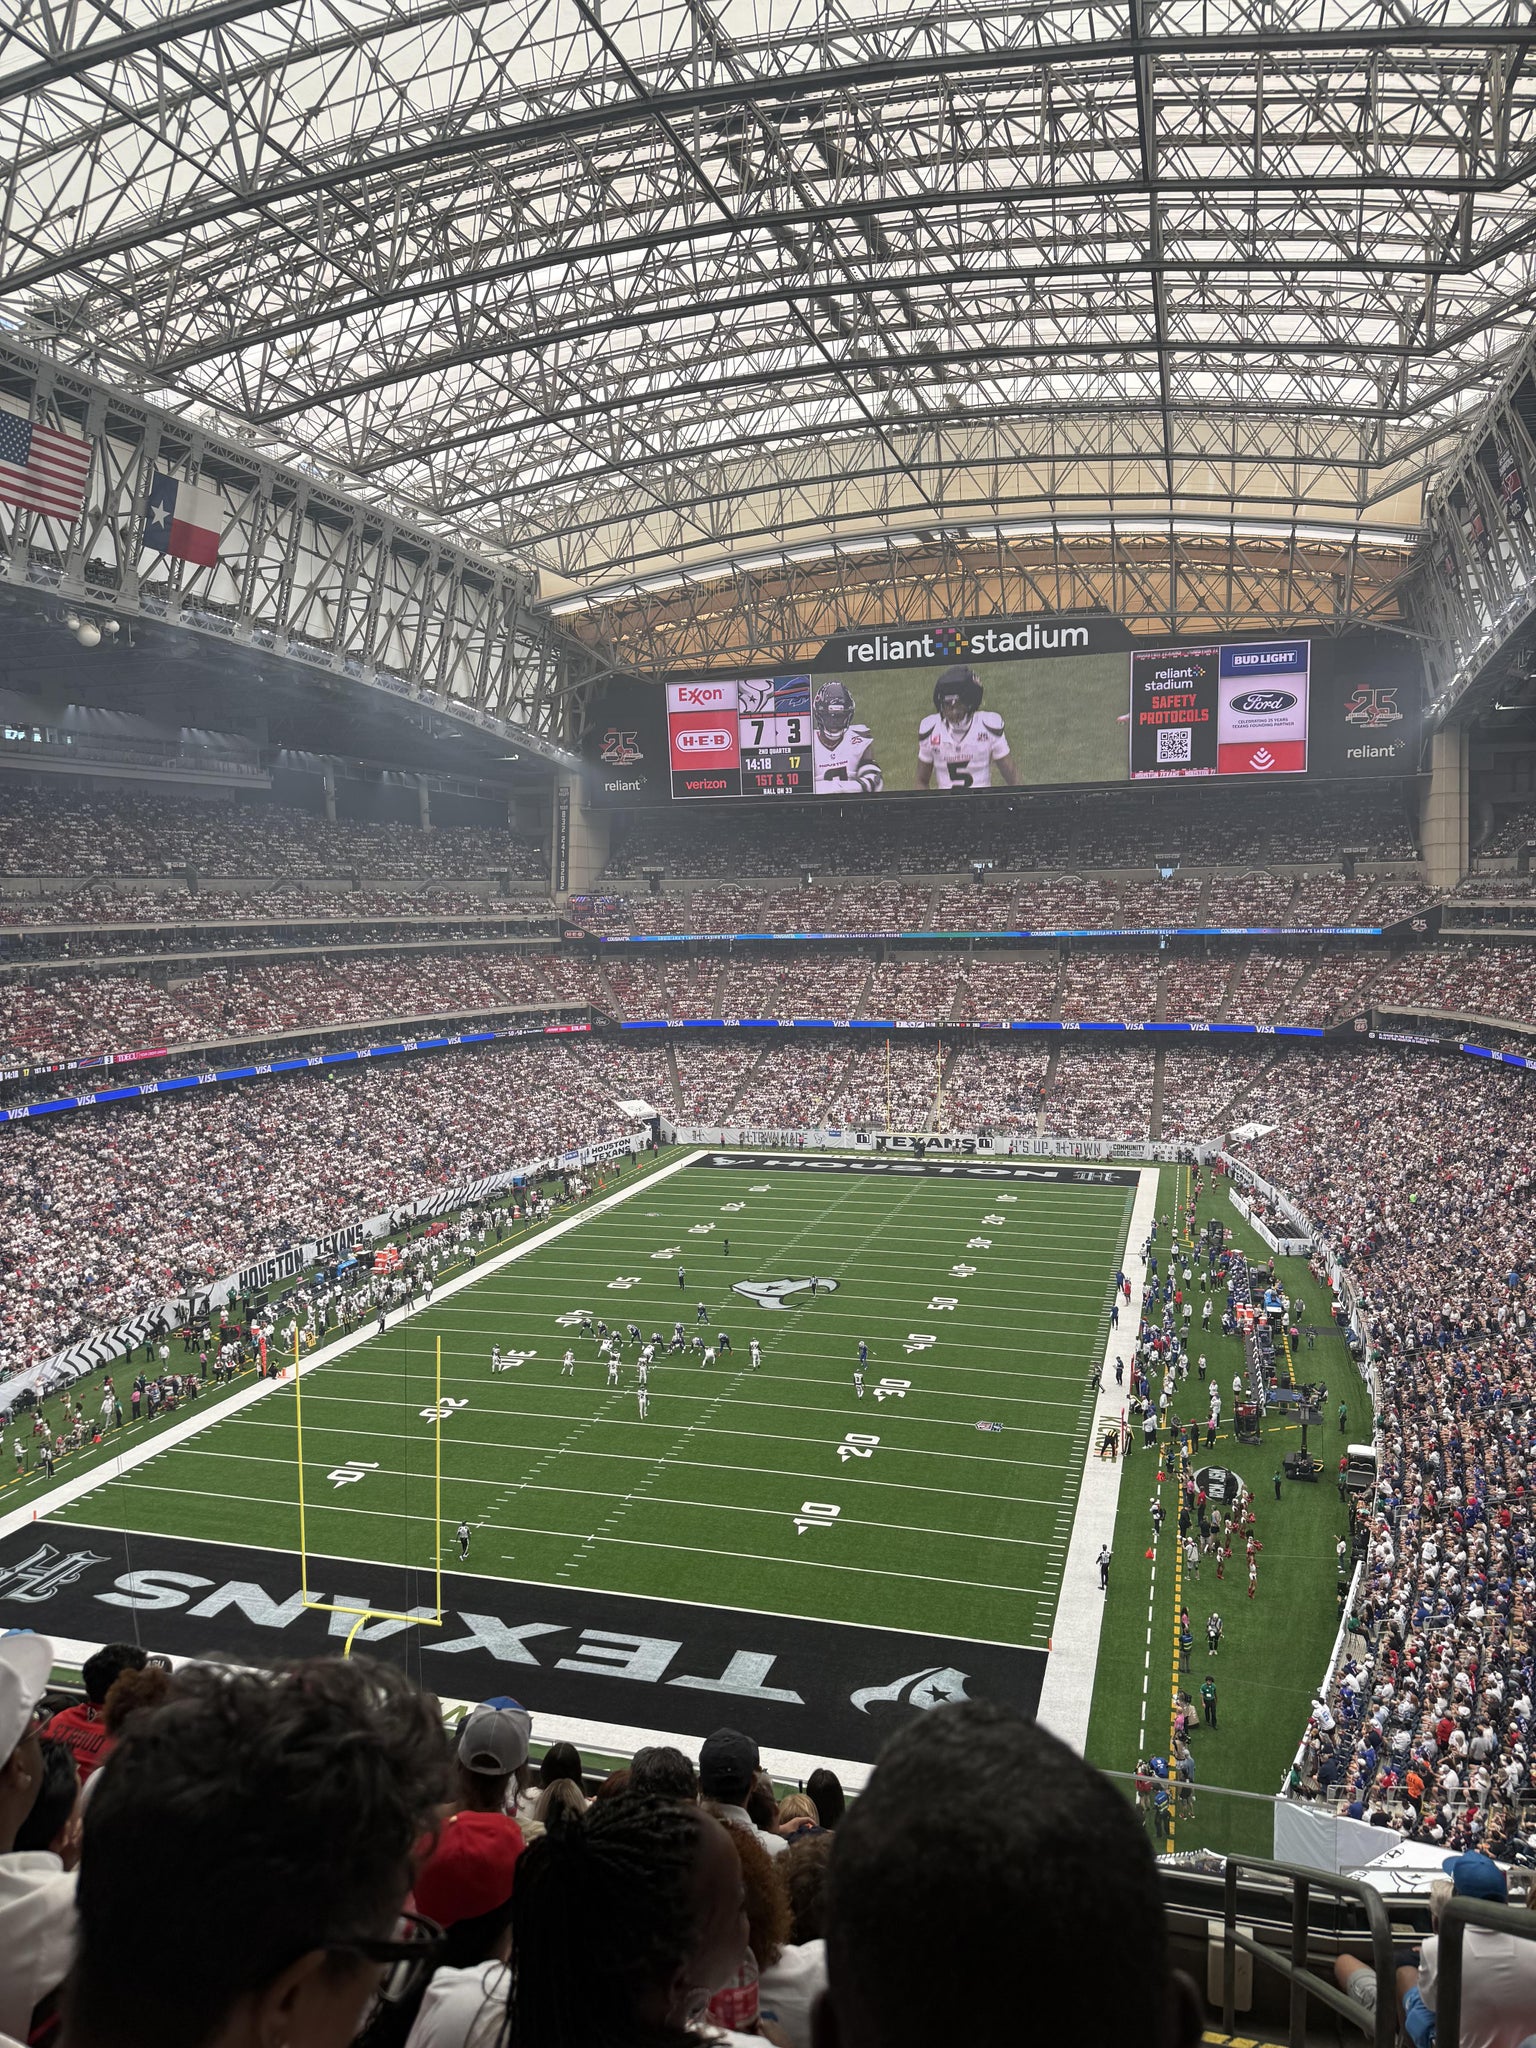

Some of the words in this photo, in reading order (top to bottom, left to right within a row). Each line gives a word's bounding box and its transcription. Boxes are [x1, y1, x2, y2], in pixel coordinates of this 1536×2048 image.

[847, 634, 935, 663] reliant
[970, 623, 1089, 655] stadium
[1234, 655, 1258, 665] BUD
[1260, 653, 1295, 663] LIGHT
[1155, 667, 1193, 679] reliant
[1144, 679, 1193, 691] stadium
[678, 688, 722, 705] Exxon
[1152, 693, 1197, 709] SAFETY
[1243, 693, 1283, 711] Ford
[1351, 688, 1398, 724] 25
[1139, 708, 1209, 725] PROTOCOLS
[751, 720, 764, 745] 7
[787, 718, 801, 743] 3
[604, 731, 639, 762] 25
[1347, 744, 1396, 759] reliant
[745, 757, 772, 770] 14:18
[789, 757, 800, 768] 17
[604, 780, 641, 791] reliant
[685, 778, 727, 790] verizon
[755, 774, 773, 786] 1ST
[776, 774, 784, 785] &
[787, 773, 799, 785] 10
[832, 1020, 850, 1028] VISA
[1060, 1022, 1080, 1030] VISA
[1124, 1023, 1145, 1031] VISA
[1189, 1023, 1210, 1032] VISA
[1255, 1025, 1276, 1034] VISA
[403, 1042, 418, 1051] VISA
[447, 1036, 462, 1045] VISA
[1491, 1050, 1503, 1061] VISA
[23, 1069, 30, 1077] 17
[7, 1106, 30, 1120] VISA
[76, 1094, 97, 1106] VISA
[139, 1083, 159, 1095] VISA
[198, 1073, 217, 1084] VISA
[255, 1064, 272, 1075] VISA
[307, 1056, 323, 1066] VISA
[356, 1049, 372, 1059] VISA
[591, 1138, 631, 1155] HOUSTON
[875, 1135, 977, 1150] TEXANS
[1113, 1143, 1145, 1151] COMMUNITY
[592, 1145, 631, 1161] TEXANS
[763, 1160, 1059, 1178] HOUSTON
[315, 1223, 363, 1256] TEXANS
[239, 1247, 304, 1290] HOUSTON
[948, 1264, 977, 1278] 40
[607, 1276, 641, 1290] 50
[927, 1296, 959, 1311] 50
[555, 1309, 594, 1324] 40
[902, 1333, 937, 1350] 40
[873, 1378, 912, 1398] 30
[419, 1397, 470, 1419] 20
[836, 1432, 880, 1458] 20
[326, 1460, 380, 1483] 10
[793, 1501, 841, 1527] 10
[93, 1569, 806, 1705] TEXANS
[52, 1724, 105, 1754] STROUD
